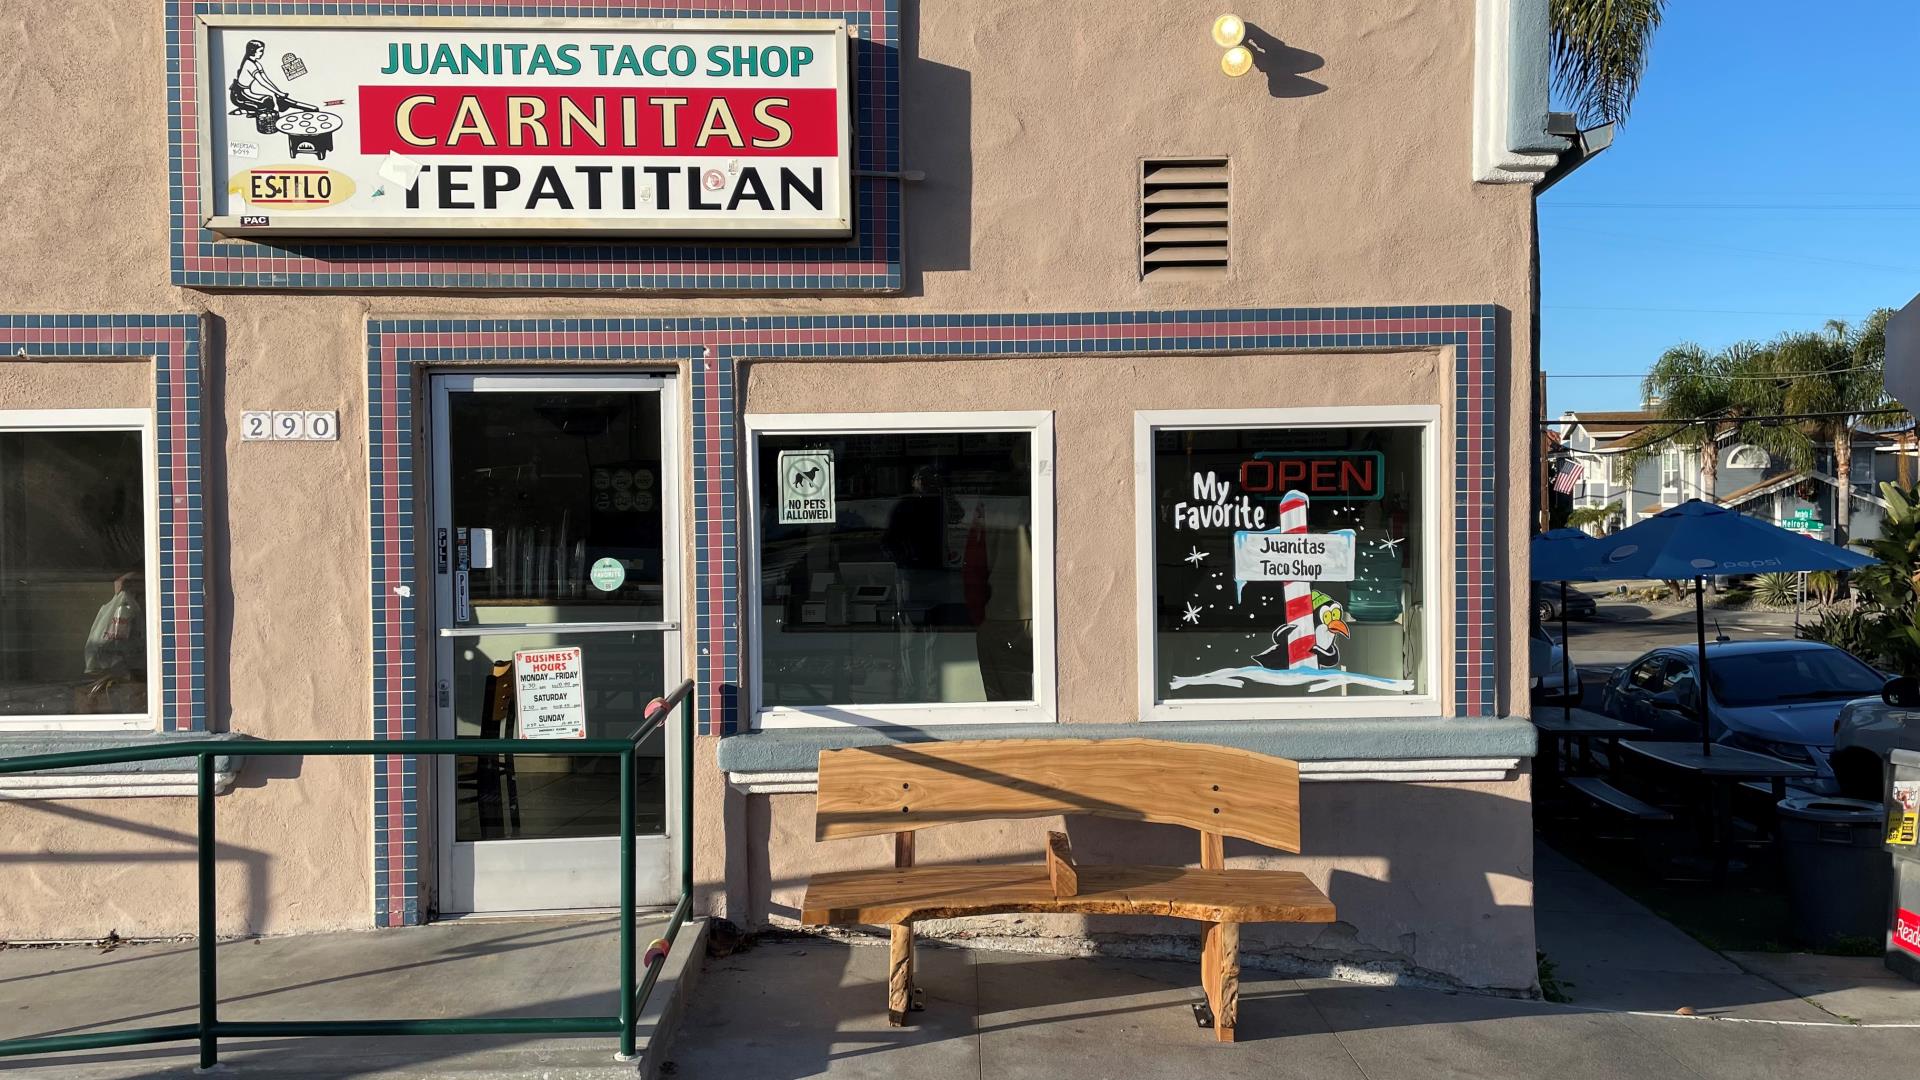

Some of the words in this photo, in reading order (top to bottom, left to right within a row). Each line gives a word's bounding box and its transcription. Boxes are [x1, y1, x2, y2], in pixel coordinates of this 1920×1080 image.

[381, 43, 582, 76] JUANITAS
[590, 44, 697, 77] TACO
[706, 45, 814, 77] SHOP
[395, 94, 794, 149] CARNITAS
[251, 175, 332, 199] ESTILO
[405, 164, 823, 211] TEPATITLAN
[244, 216, 267, 225] PAC
[250, 417, 329, 437] 290
[1240, 459, 1373, 492] OPEN
[1193, 471, 1230, 505] My
[789, 499, 801, 510] NO
[804, 499, 826, 509] PETS
[1174, 495, 1266, 530] Favorite
[786, 509, 828, 520] ALLOWED
[1782, 519, 1809, 528] Melrose
[439, 531, 447, 564] PULL
[1259, 537, 1326, 555] Juanitas
[1259, 559, 1290, 576] Taco
[1292, 559, 1322, 580] Shop
[1723, 557, 1782, 569] pepsi
[520, 673, 549, 682] MONDAY
[555, 671, 578, 680] FRIDAY
[533, 663, 567, 672] HOURS
[533, 693, 567, 702] SATURDAY
[538, 713, 565, 723] SUNDAY
